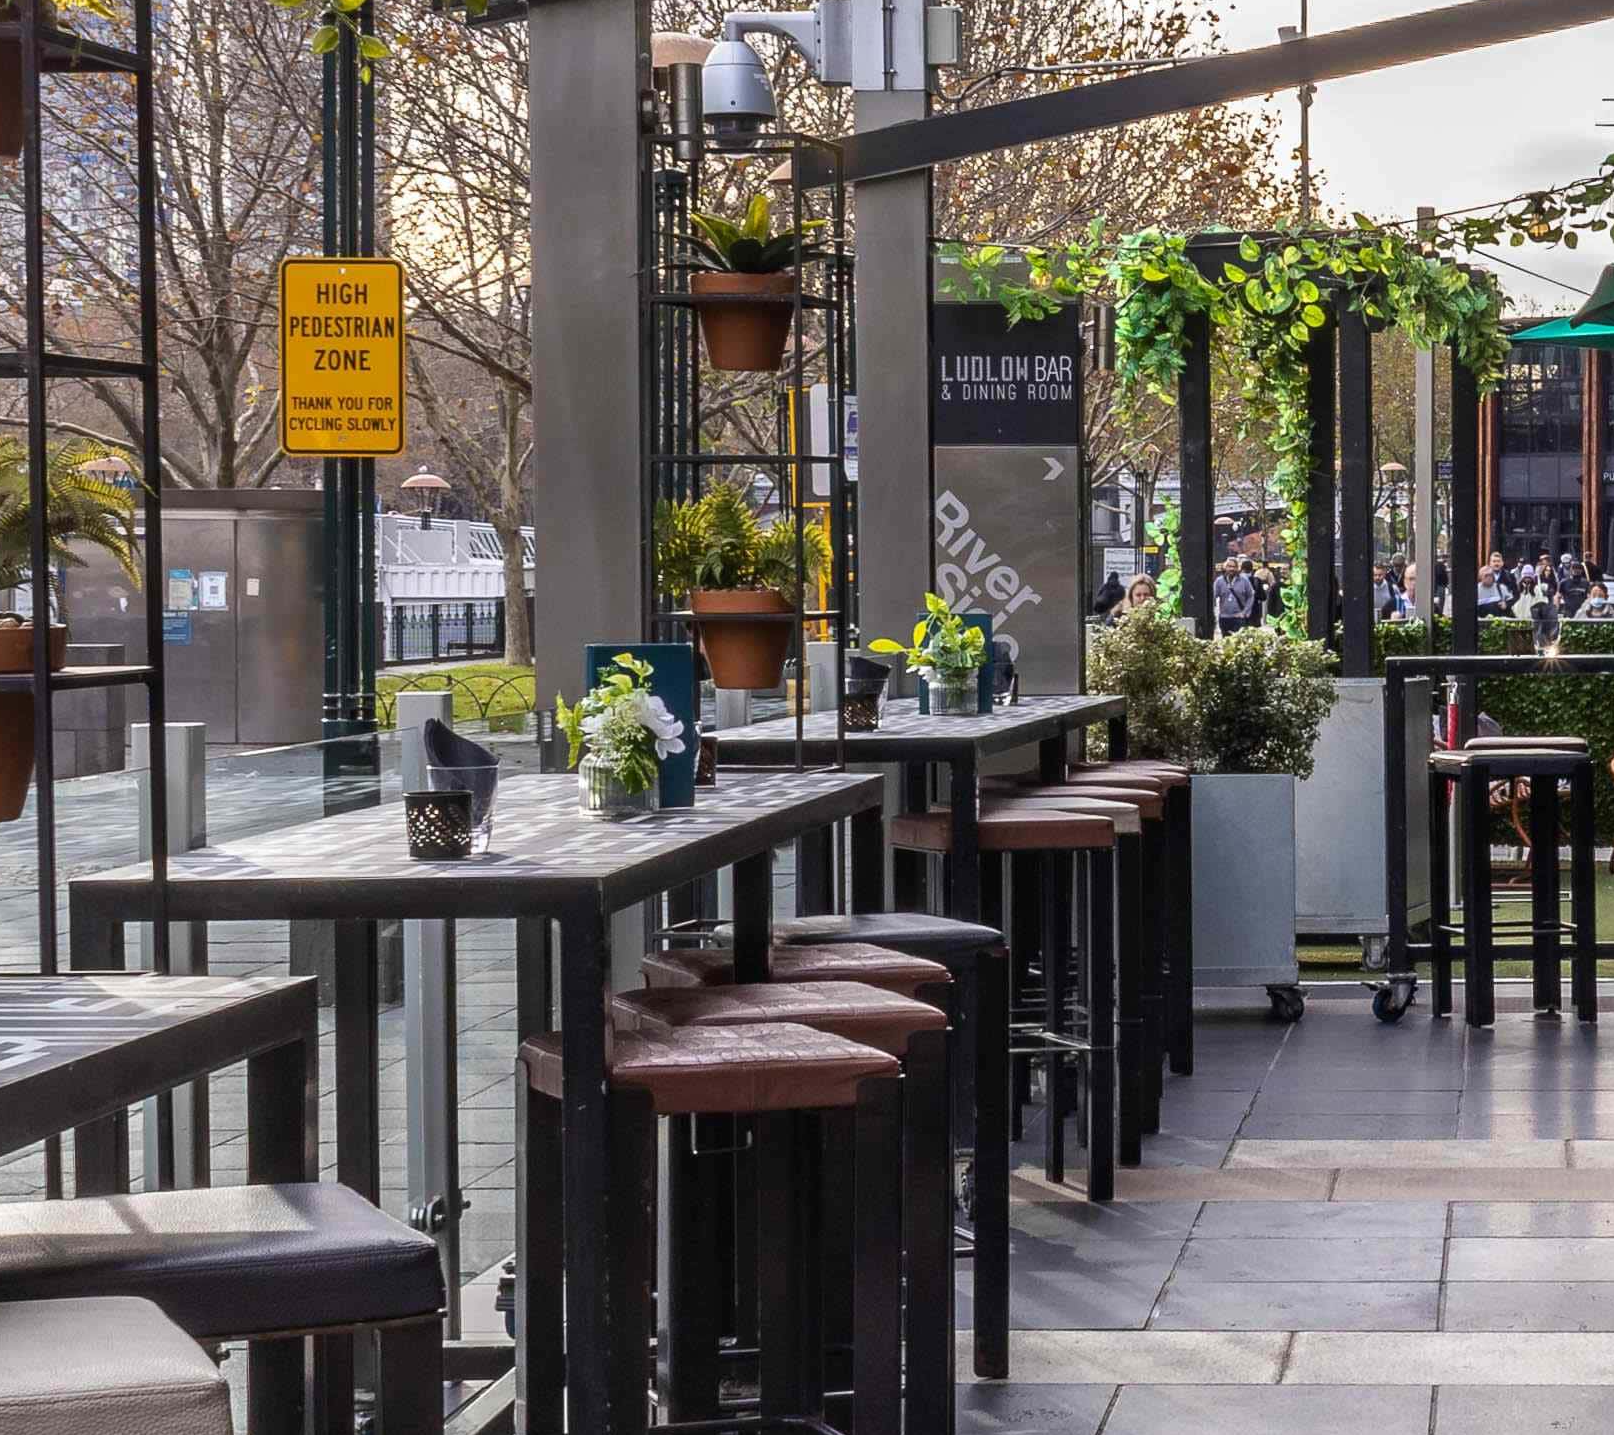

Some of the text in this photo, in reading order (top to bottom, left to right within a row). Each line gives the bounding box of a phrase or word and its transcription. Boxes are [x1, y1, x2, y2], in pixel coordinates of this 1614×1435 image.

[316, 283, 368, 304] HIGH
[289, 316, 395, 338] PEDESTRIAN
[313, 349, 371, 371] ZONE
[941, 355, 1073, 382] LUDLOW BAR
[941, 383, 1073, 400] & DINING ROOM
[291, 396, 393, 410] THANK YOU FOR
[289, 417, 396, 431] CYCLING SLOWLY
[936, 490, 1043, 615] River
